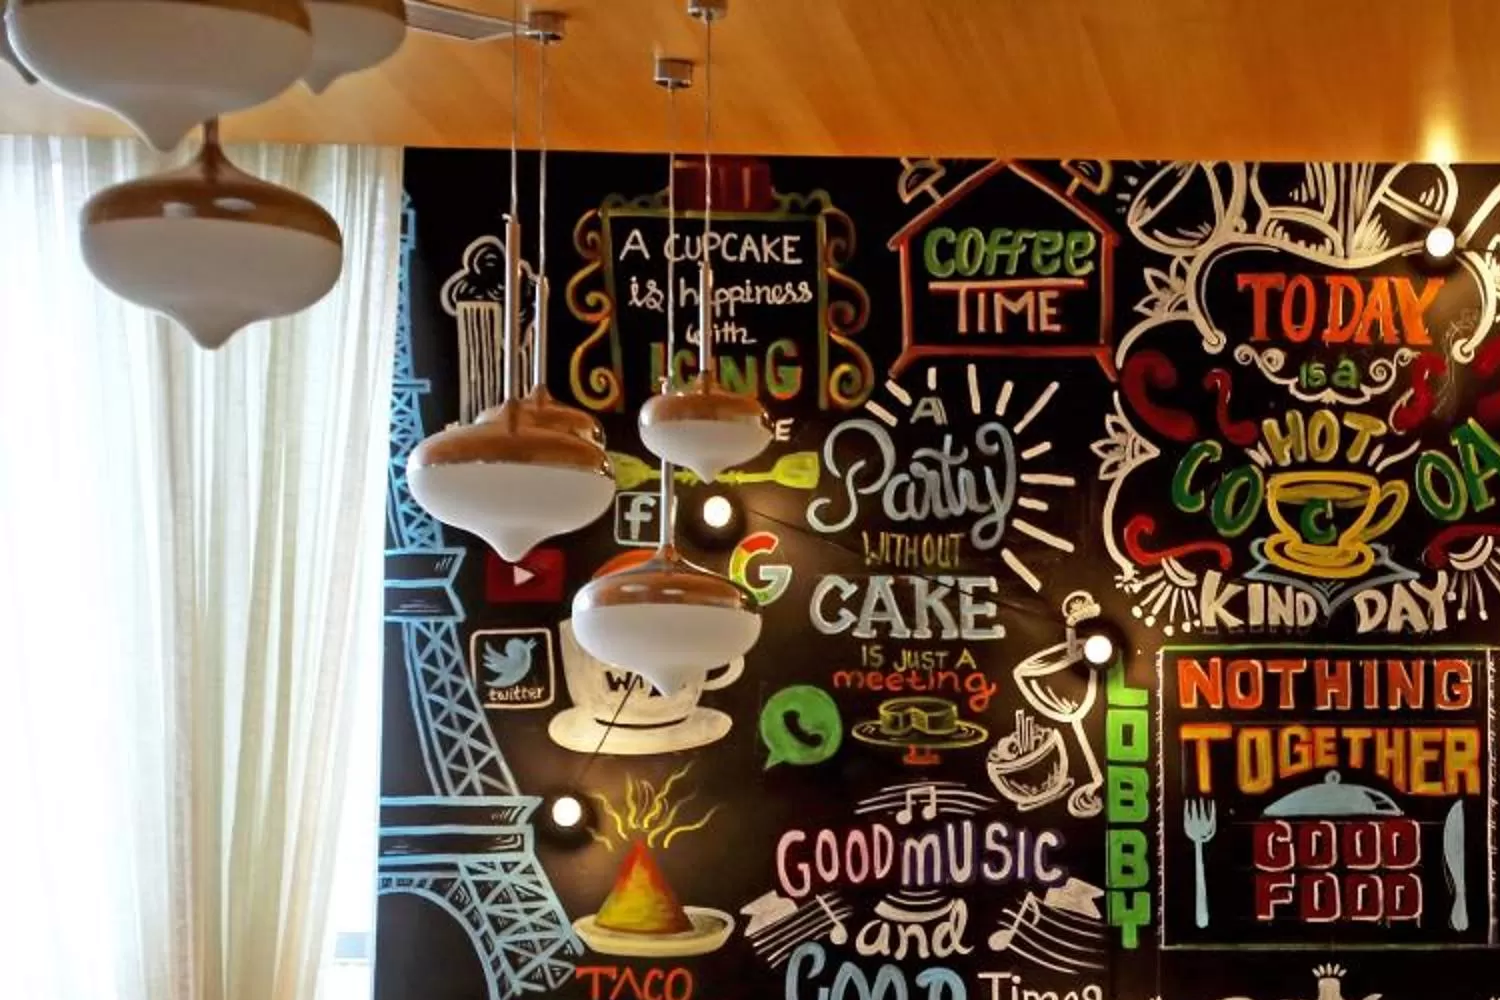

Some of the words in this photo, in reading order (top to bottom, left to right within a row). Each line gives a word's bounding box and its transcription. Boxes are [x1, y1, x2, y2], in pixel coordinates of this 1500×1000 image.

[619, 228, 651, 261] A
[664, 231, 803, 264] CUPCAKE
[628, 275, 665, 312] is
[679, 276, 813, 318] hppiness
[957, 282, 1062, 333] TIME
[1237, 273, 1445, 345] TODAY
[650, 339, 803, 399] ICNG
[910, 396, 949, 425] A
[1262, 408, 1388, 468] HOT
[806, 418, 1017, 550] Party
[861, 530, 967, 567] WITHOUT
[808, 573, 1007, 640] CAKE
[1200, 569, 1317, 630] KIND
[1352, 569, 1450, 634] DAY
[860, 643, 884, 668] IS
[892, 650, 948, 673] JUST
[955, 647, 977, 670] A
[1176, 655, 1473, 710] NOTHING
[832, 670, 998, 713] meeting
[1178, 721, 1482, 797] TOGETHER
[1106, 650, 1151, 949] LOBBY
[776, 823, 894, 897] GOOD
[1252, 818, 1422, 873] GOOD
[1254, 871, 1423, 924] FOOD
[855, 898, 975, 960] and
